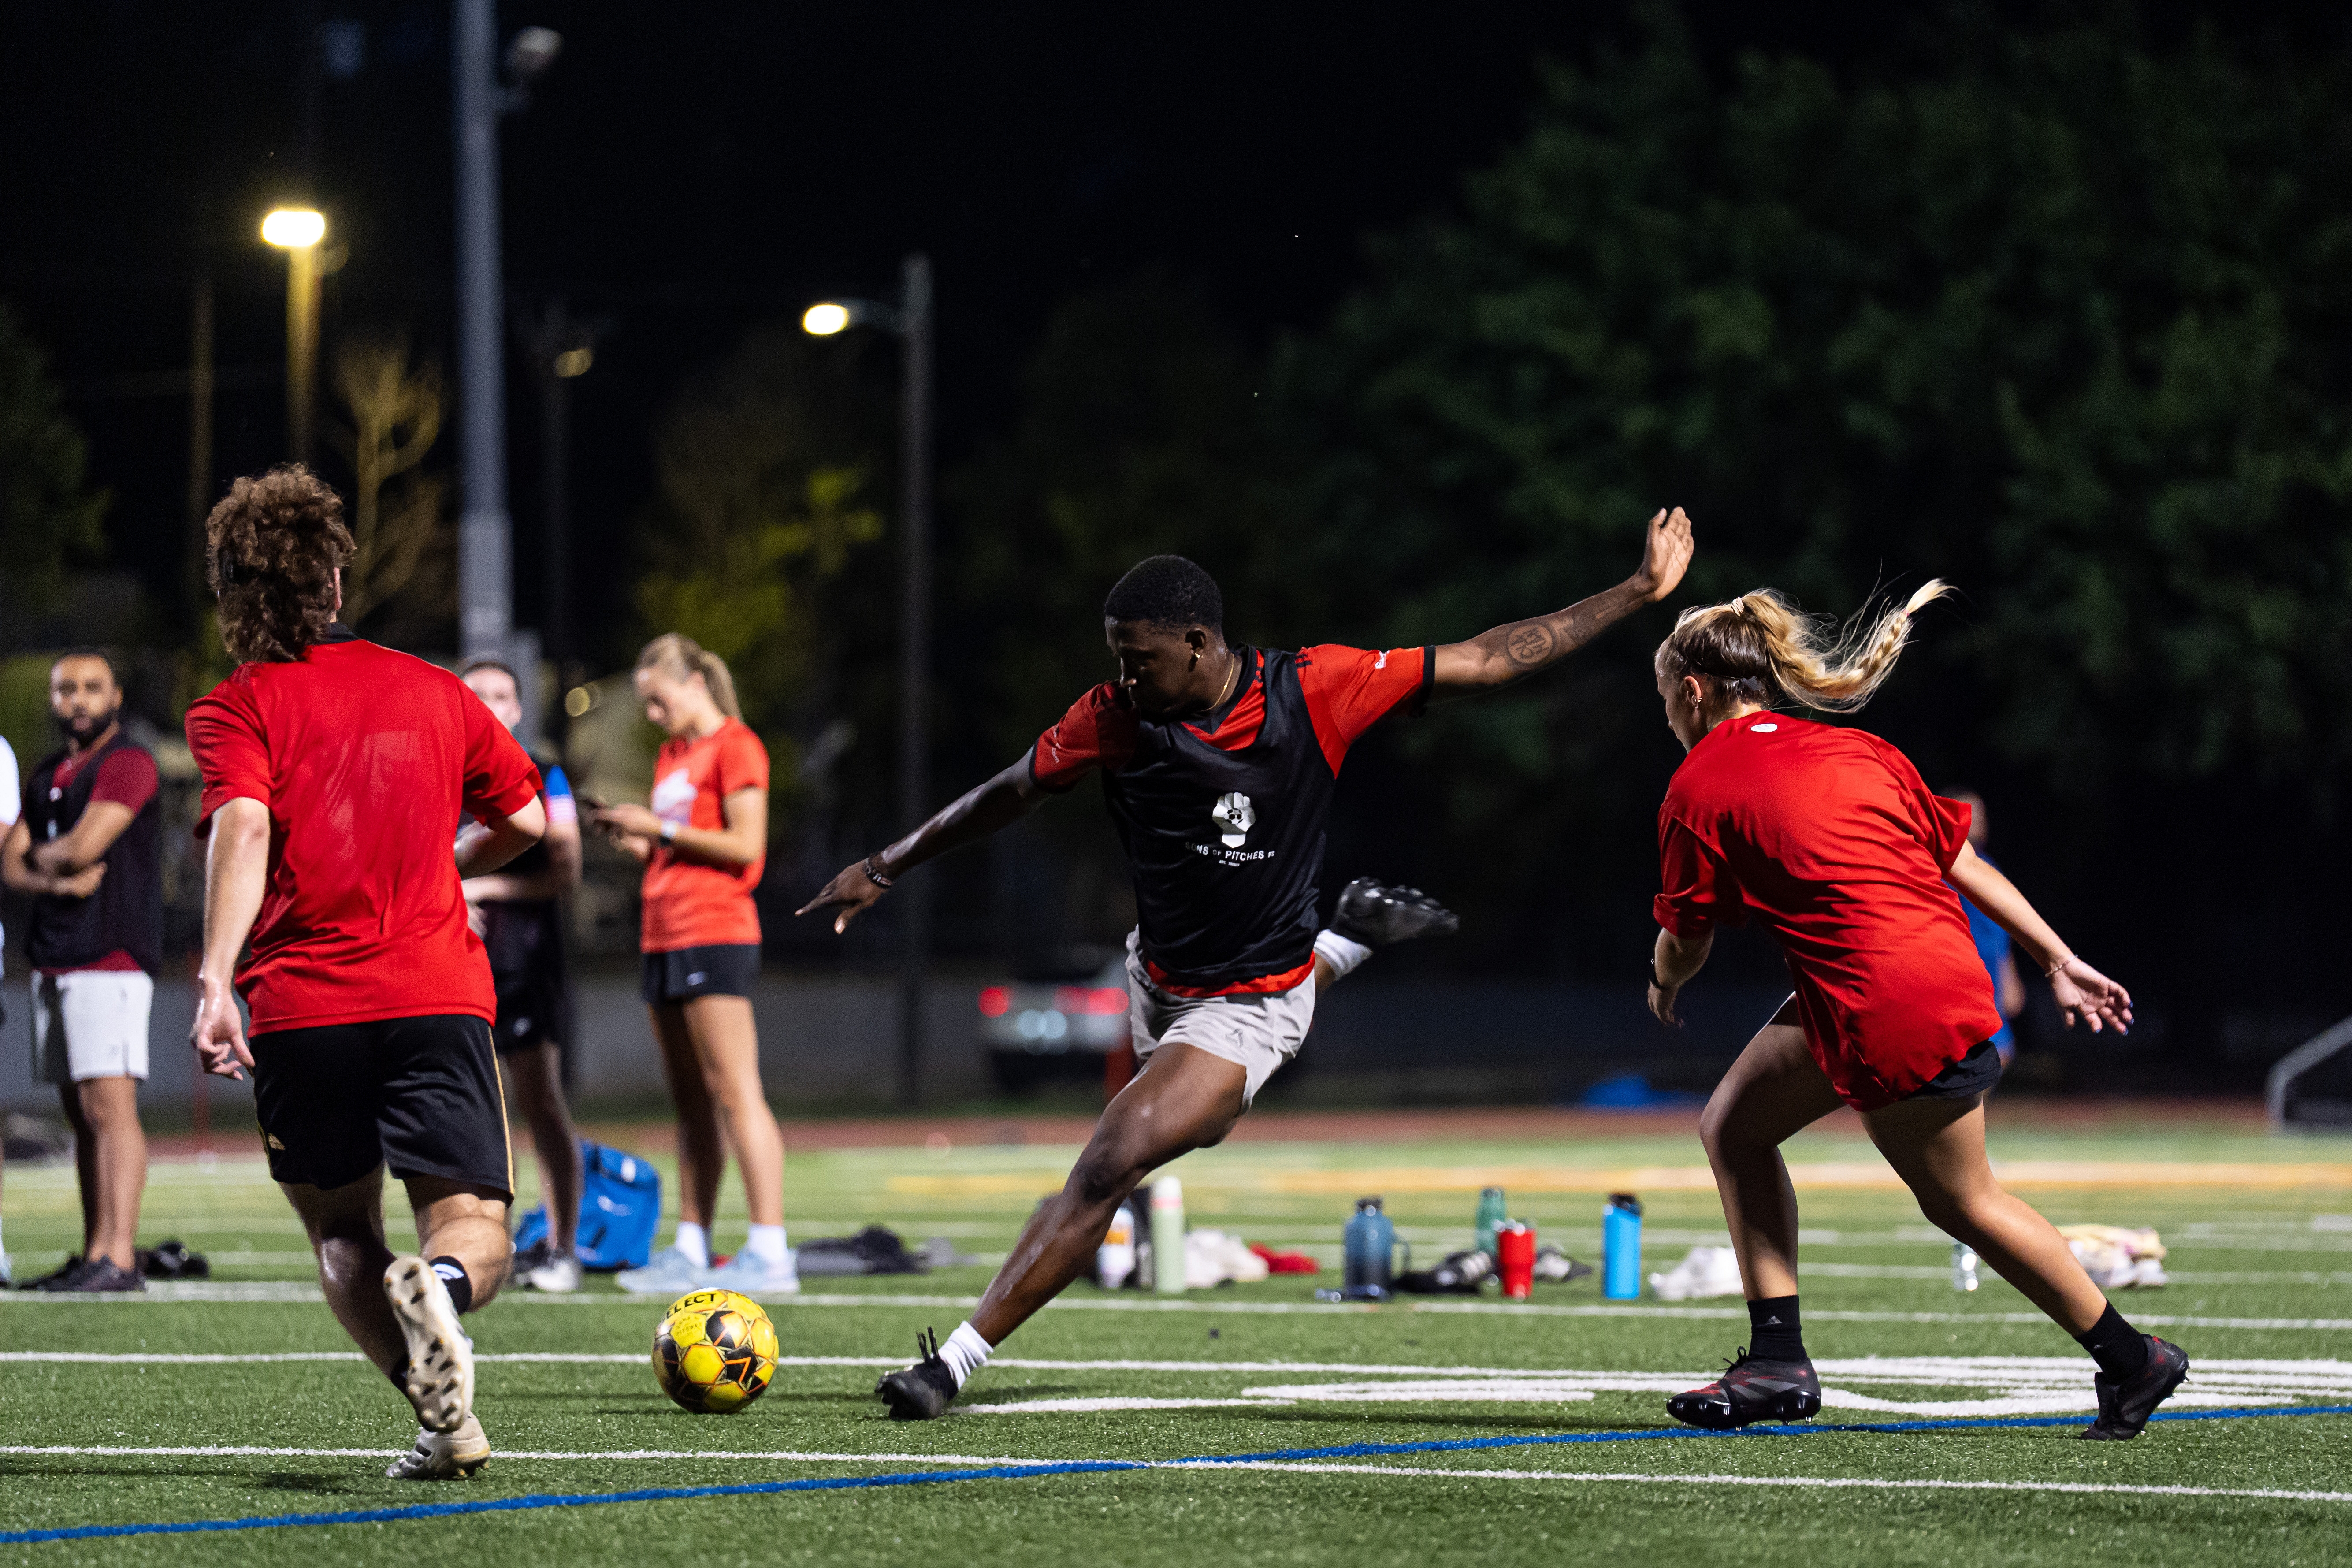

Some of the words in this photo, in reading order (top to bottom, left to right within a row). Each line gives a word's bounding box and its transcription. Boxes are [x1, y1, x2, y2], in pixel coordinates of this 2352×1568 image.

[1185, 842, 1208, 855] SONS
[1225, 850, 1264, 861] PITCHES
[666, 1293, 717, 1319] ELECT
